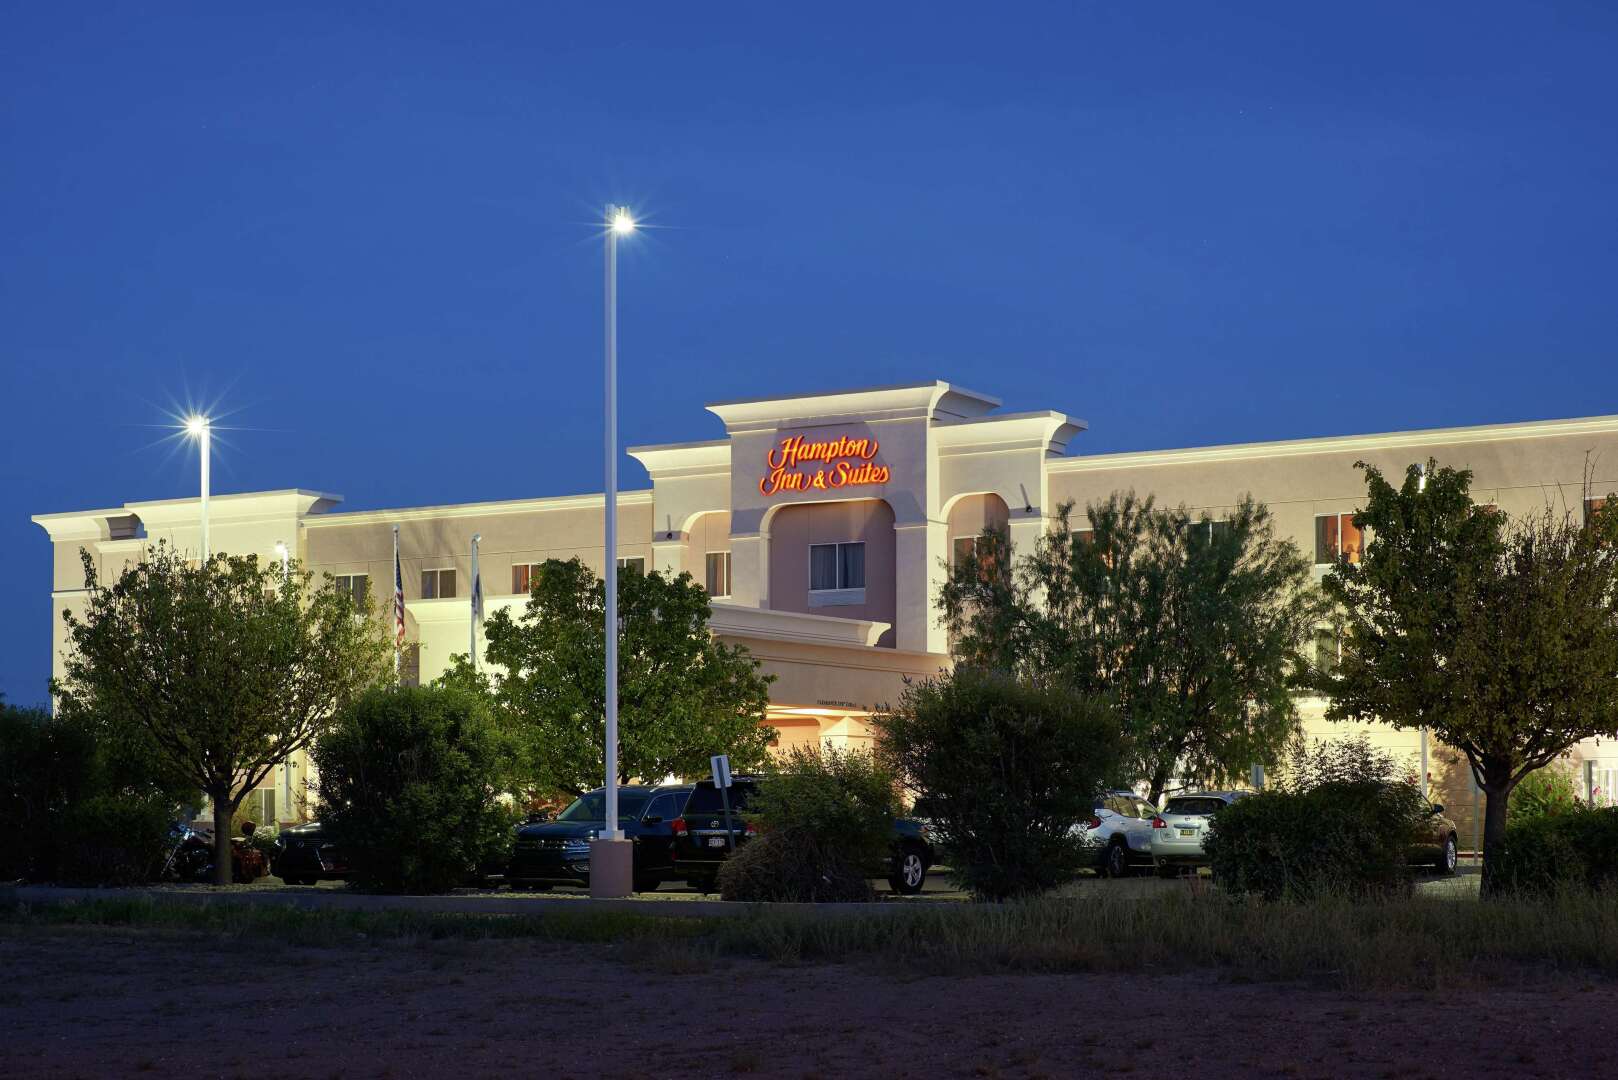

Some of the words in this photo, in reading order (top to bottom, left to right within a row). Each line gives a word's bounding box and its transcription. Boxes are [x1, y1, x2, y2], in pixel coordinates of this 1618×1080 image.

[768, 435, 878, 469] Hampton
[759, 467, 811, 496] Inn
[813, 470, 827, 489] &
[829, 461, 889, 487] Suites
